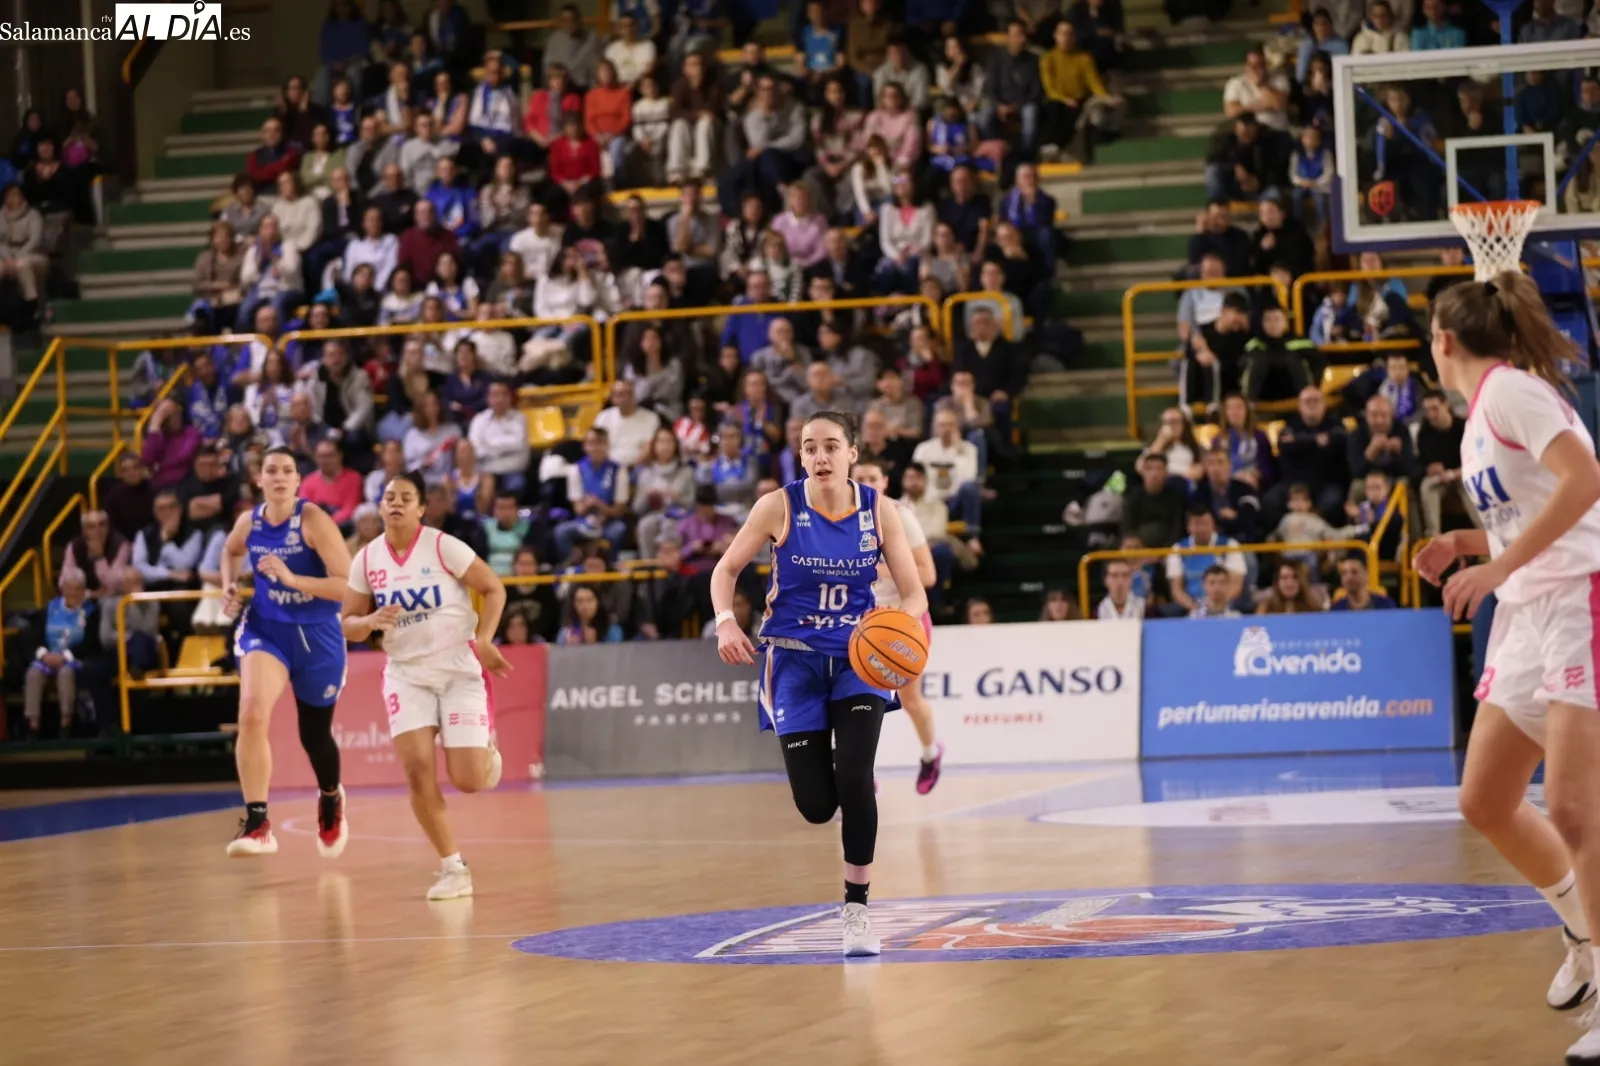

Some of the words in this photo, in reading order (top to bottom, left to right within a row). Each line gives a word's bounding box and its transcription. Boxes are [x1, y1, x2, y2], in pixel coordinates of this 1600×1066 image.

[791, 554, 845, 568] CASTILLA
[846, 559, 856, 570] Y
[826, 569, 861, 577] IMPULSA
[368, 569, 388, 589] 22
[818, 583, 849, 611] 10
[921, 671, 961, 699] EL
[976, 665, 1124, 699] GANSO
[550, 685, 644, 710] ANGEL
[654, 680, 760, 706] SCHLES
[1157, 694, 1434, 730] perfumeriasavenida.com
[787, 739, 809, 750] NIKE
